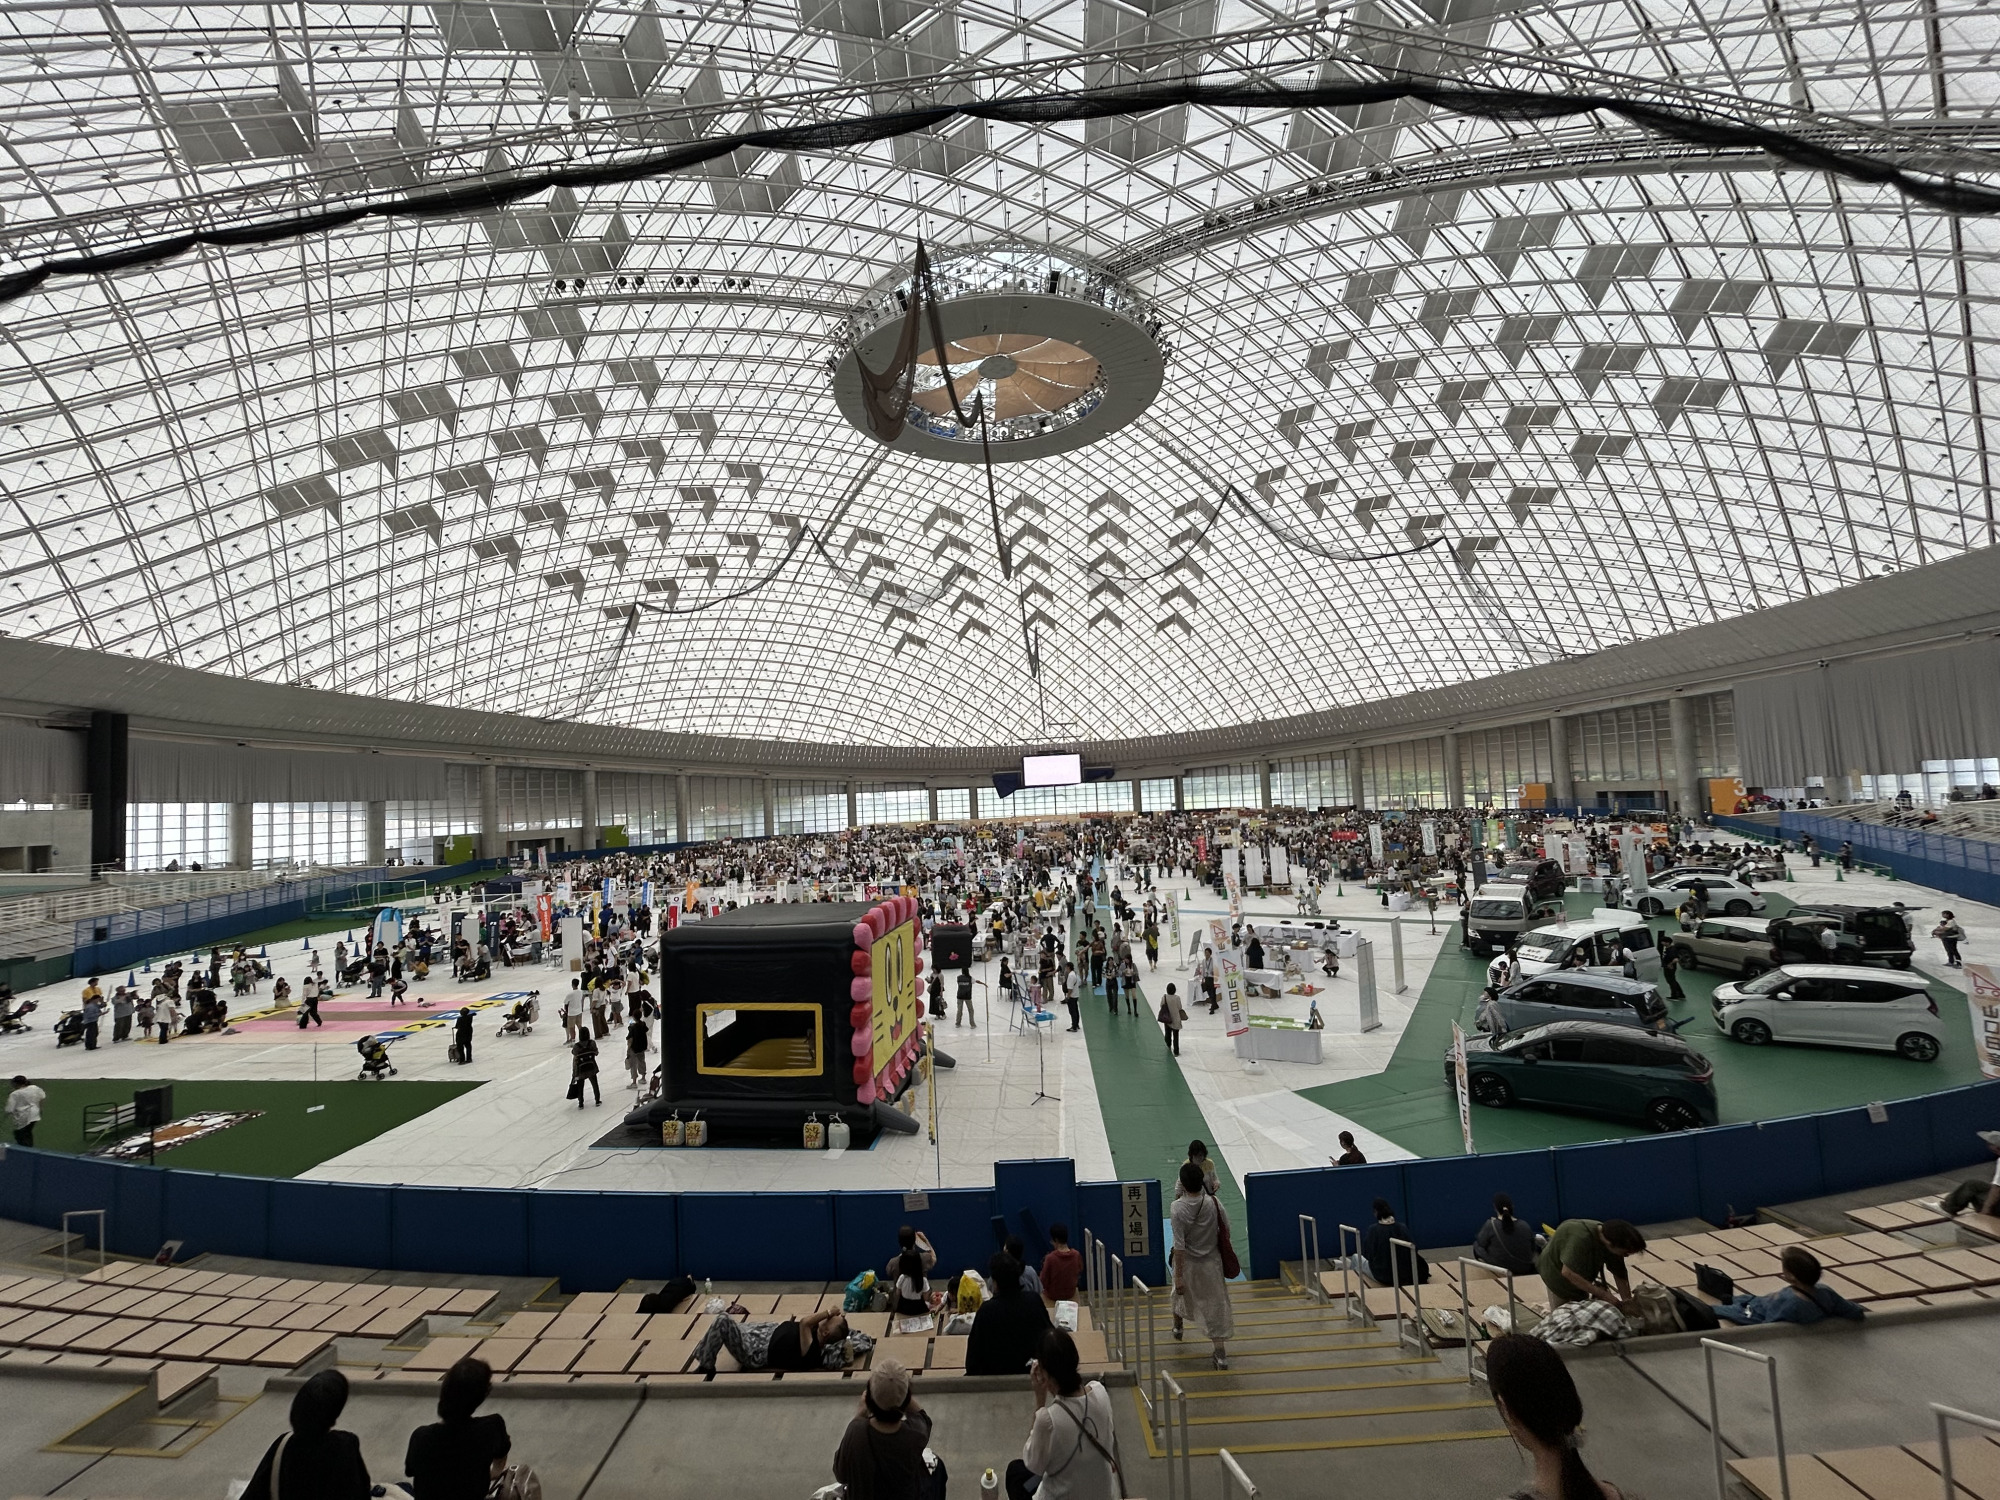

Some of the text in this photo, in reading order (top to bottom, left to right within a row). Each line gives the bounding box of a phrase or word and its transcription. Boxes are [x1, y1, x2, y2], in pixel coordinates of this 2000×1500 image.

[1517, 783, 1527, 798] 3
[1733, 778, 1747, 796] 3
[621, 824, 629, 837] 4
[444, 835, 455, 850] 4
[1227, 979, 1242, 1024] 山口日産
[1127, 1185, 1143, 1254] 再入場口
